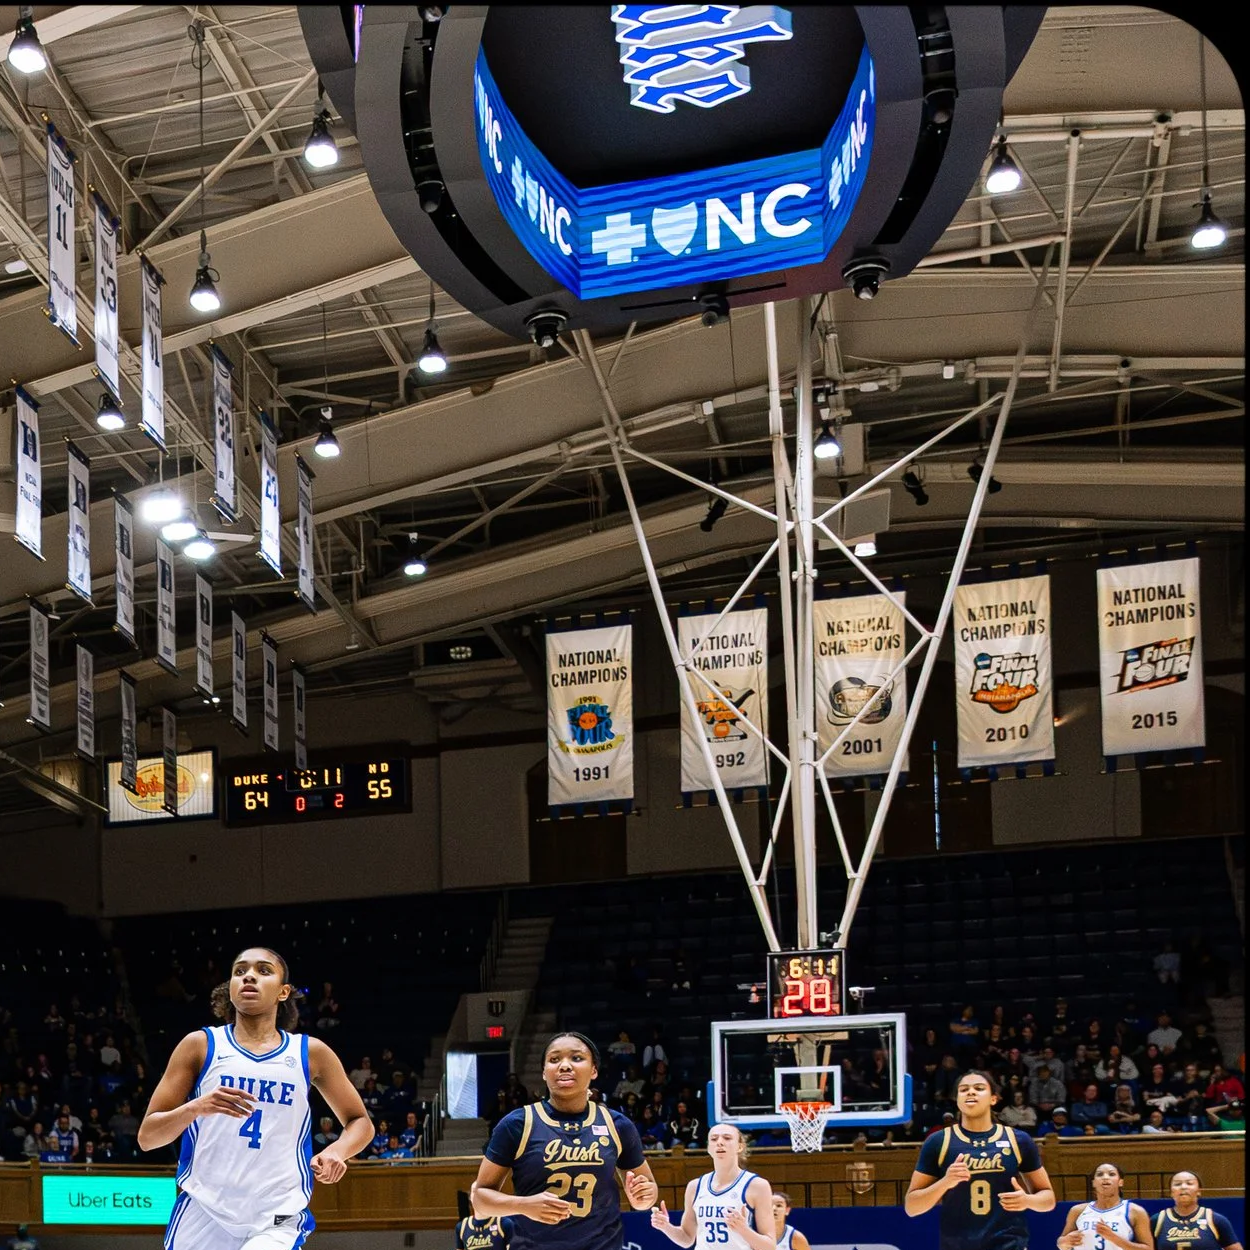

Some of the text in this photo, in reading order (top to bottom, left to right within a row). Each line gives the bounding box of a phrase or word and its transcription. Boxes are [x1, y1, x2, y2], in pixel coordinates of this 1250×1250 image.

[611, 5, 793, 114] uke
[56, 204, 68, 250] 11
[540, 186, 573, 255] NC
[706, 184, 812, 251] NC
[1113, 584, 1186, 606] NATIONAL
[968, 600, 1037, 622] NATIONAL
[1104, 602, 1196, 628] CHAMPIONS
[827, 616, 893, 637] NATIONAL
[961, 618, 1045, 643] CHAMPIONS
[819, 634, 901, 657] CHAMPIONS
[559, 648, 620, 668] NATIONAL
[692, 650, 762, 672] HAMPIONS
[990, 654, 1037, 679] FINAL
[551, 666, 627, 687] CHAMPIONS
[1131, 711, 1178, 730] 2015
[986, 724, 1030, 742] 2010
[842, 738, 883, 755] 2001
[715, 751, 746, 768] 992
[234, 774, 269, 787] DUKE
[573, 766, 610, 781] 1991
[244, 791, 269, 810] 64
[367, 779, 392, 800] 55
[335, 794, 344, 808] 2
[783, 979, 831, 1014] 28
[238, 1108, 263, 1149] 4
[543, 1138, 604, 1168] Irish
[69, 1192, 152, 1209] Uber Eats
[970, 1180, 991, 1215] 8
[705, 1221, 730, 1243] 35
